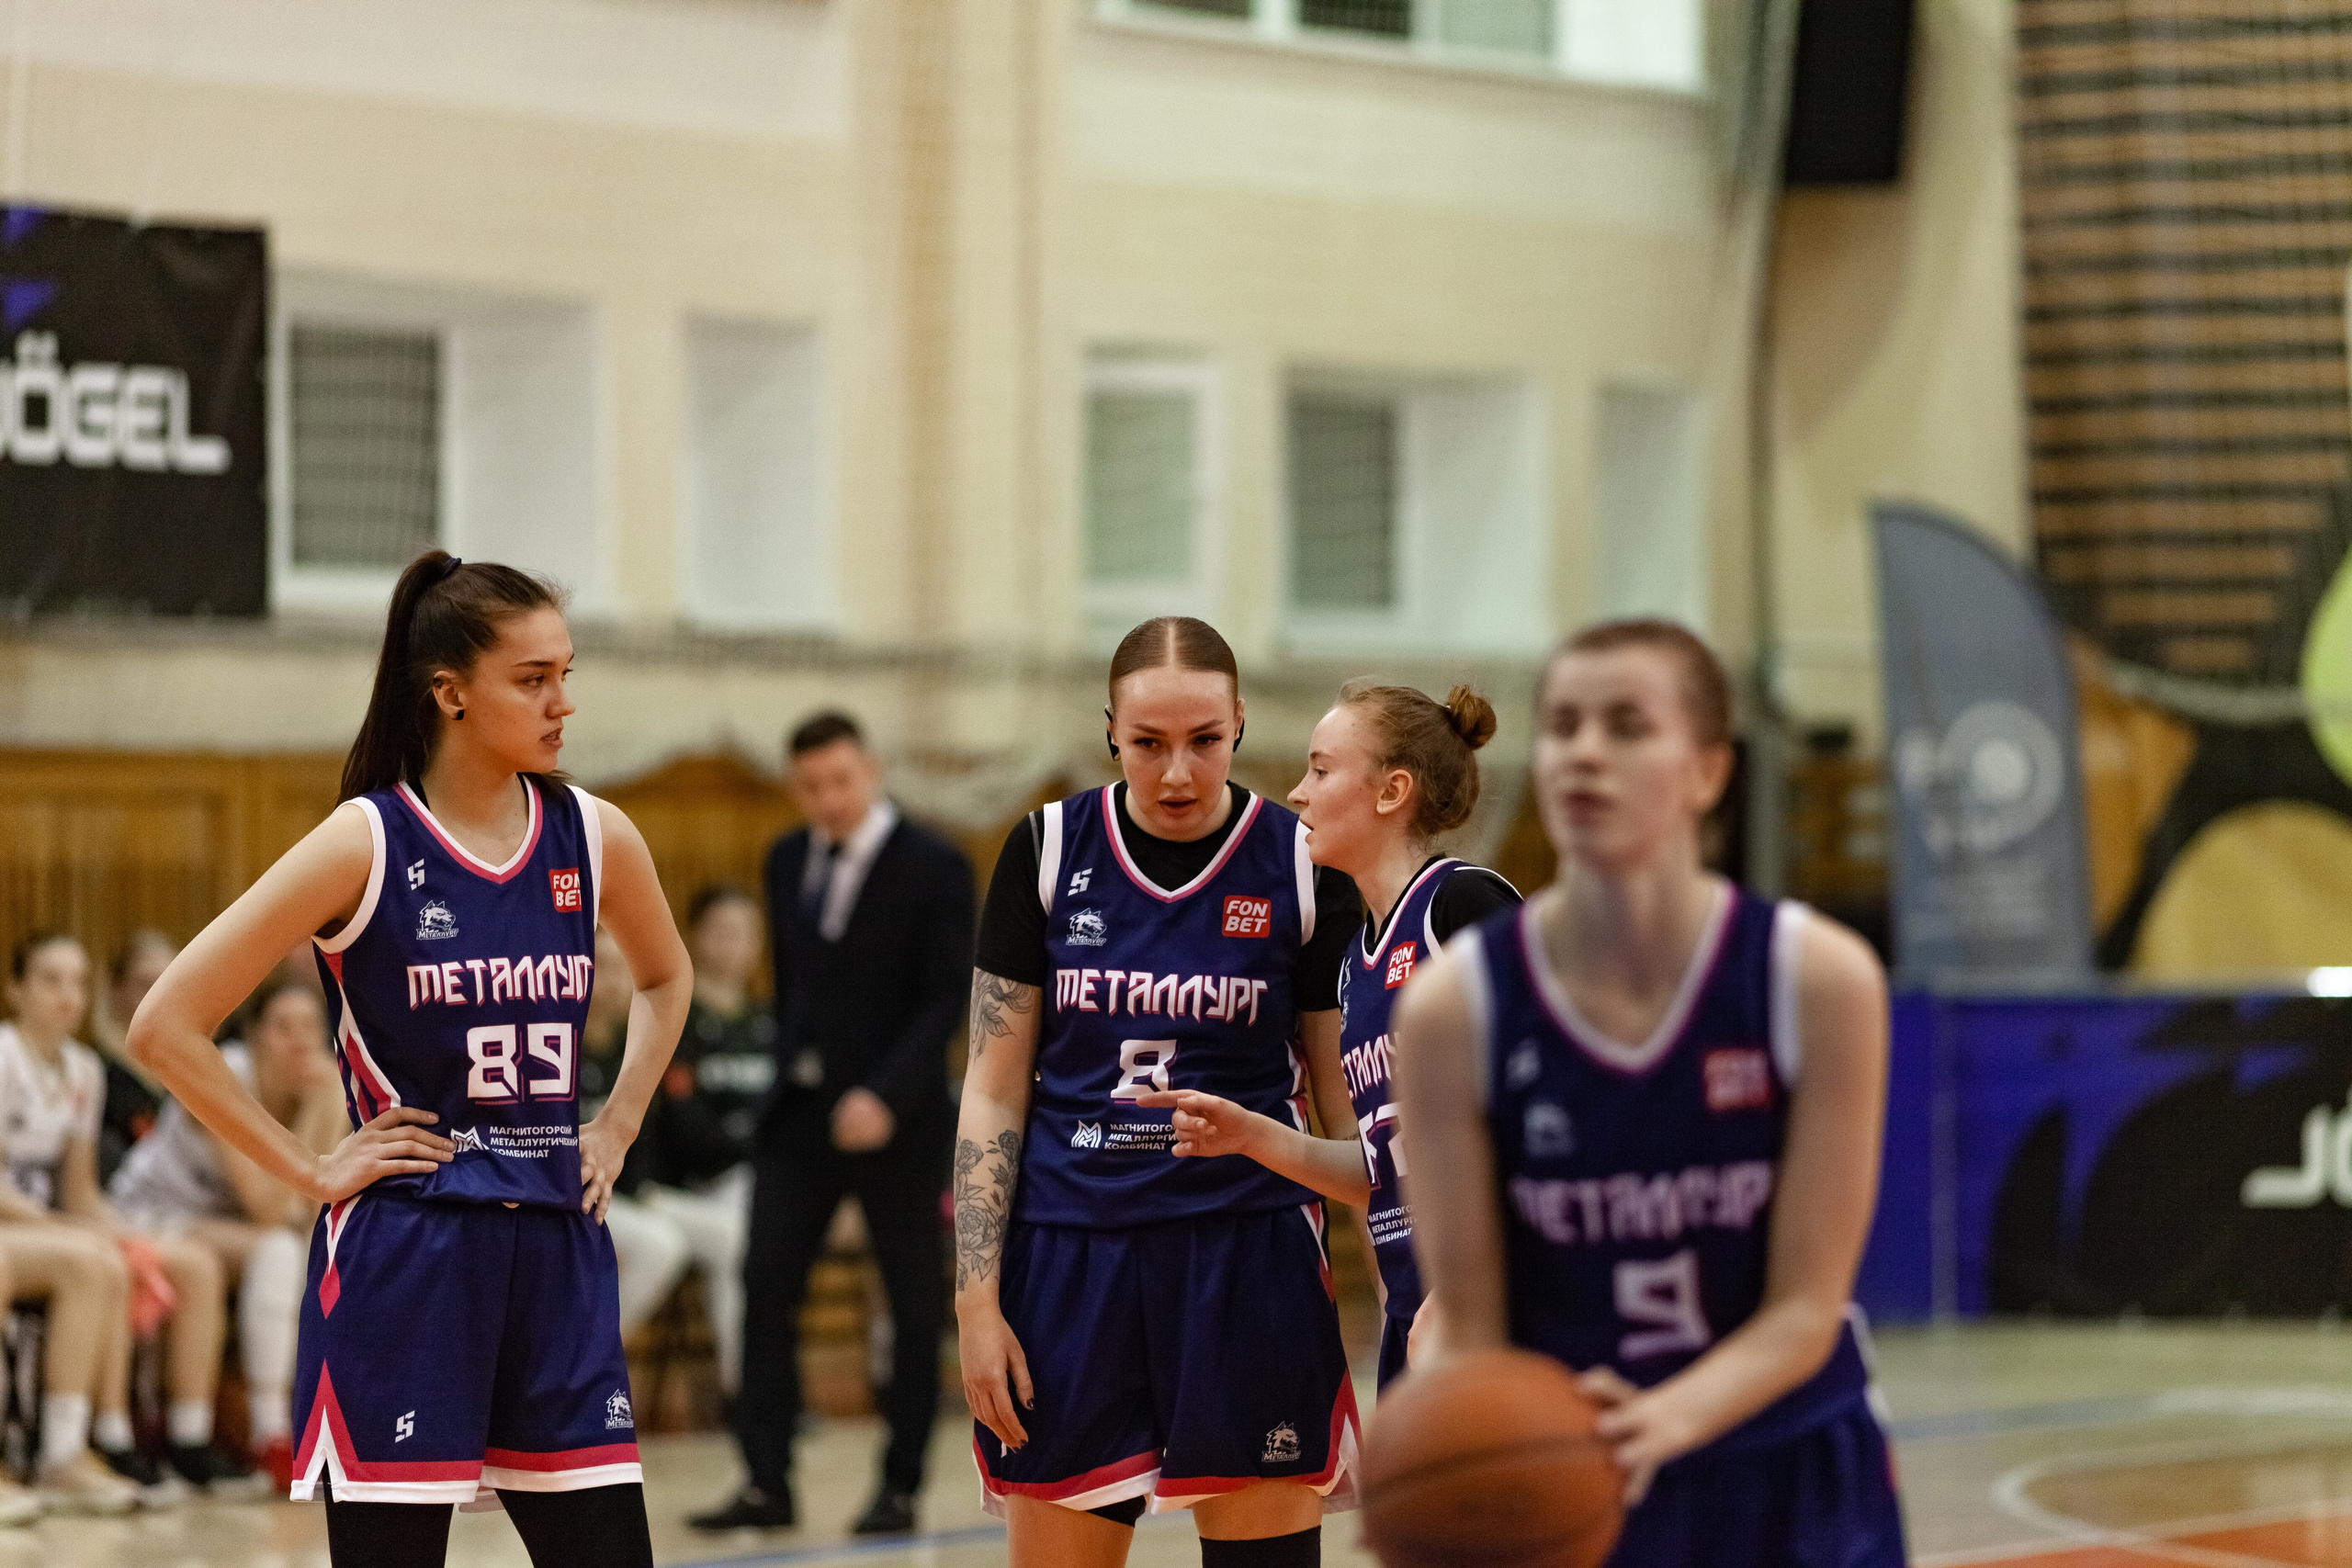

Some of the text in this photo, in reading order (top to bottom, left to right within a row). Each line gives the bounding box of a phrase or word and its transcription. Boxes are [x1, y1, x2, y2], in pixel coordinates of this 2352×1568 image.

[0, 329, 232, 474] ÖGEL
[1227, 900, 1268, 917] FON
[1225, 918, 1267, 933] BET
[1388, 945, 1415, 967] FON
[1385, 961, 1414, 985] BET
[1057, 968, 1269, 1027] МЕТАЛЛУРГ
[467, 1022, 577, 1104] 89
[1110, 1039, 1180, 1104] 8
[1110, 1123, 1176, 1133] МАГНИТОГО
[1104, 1142, 1166, 1150] КОМБИНАТ
